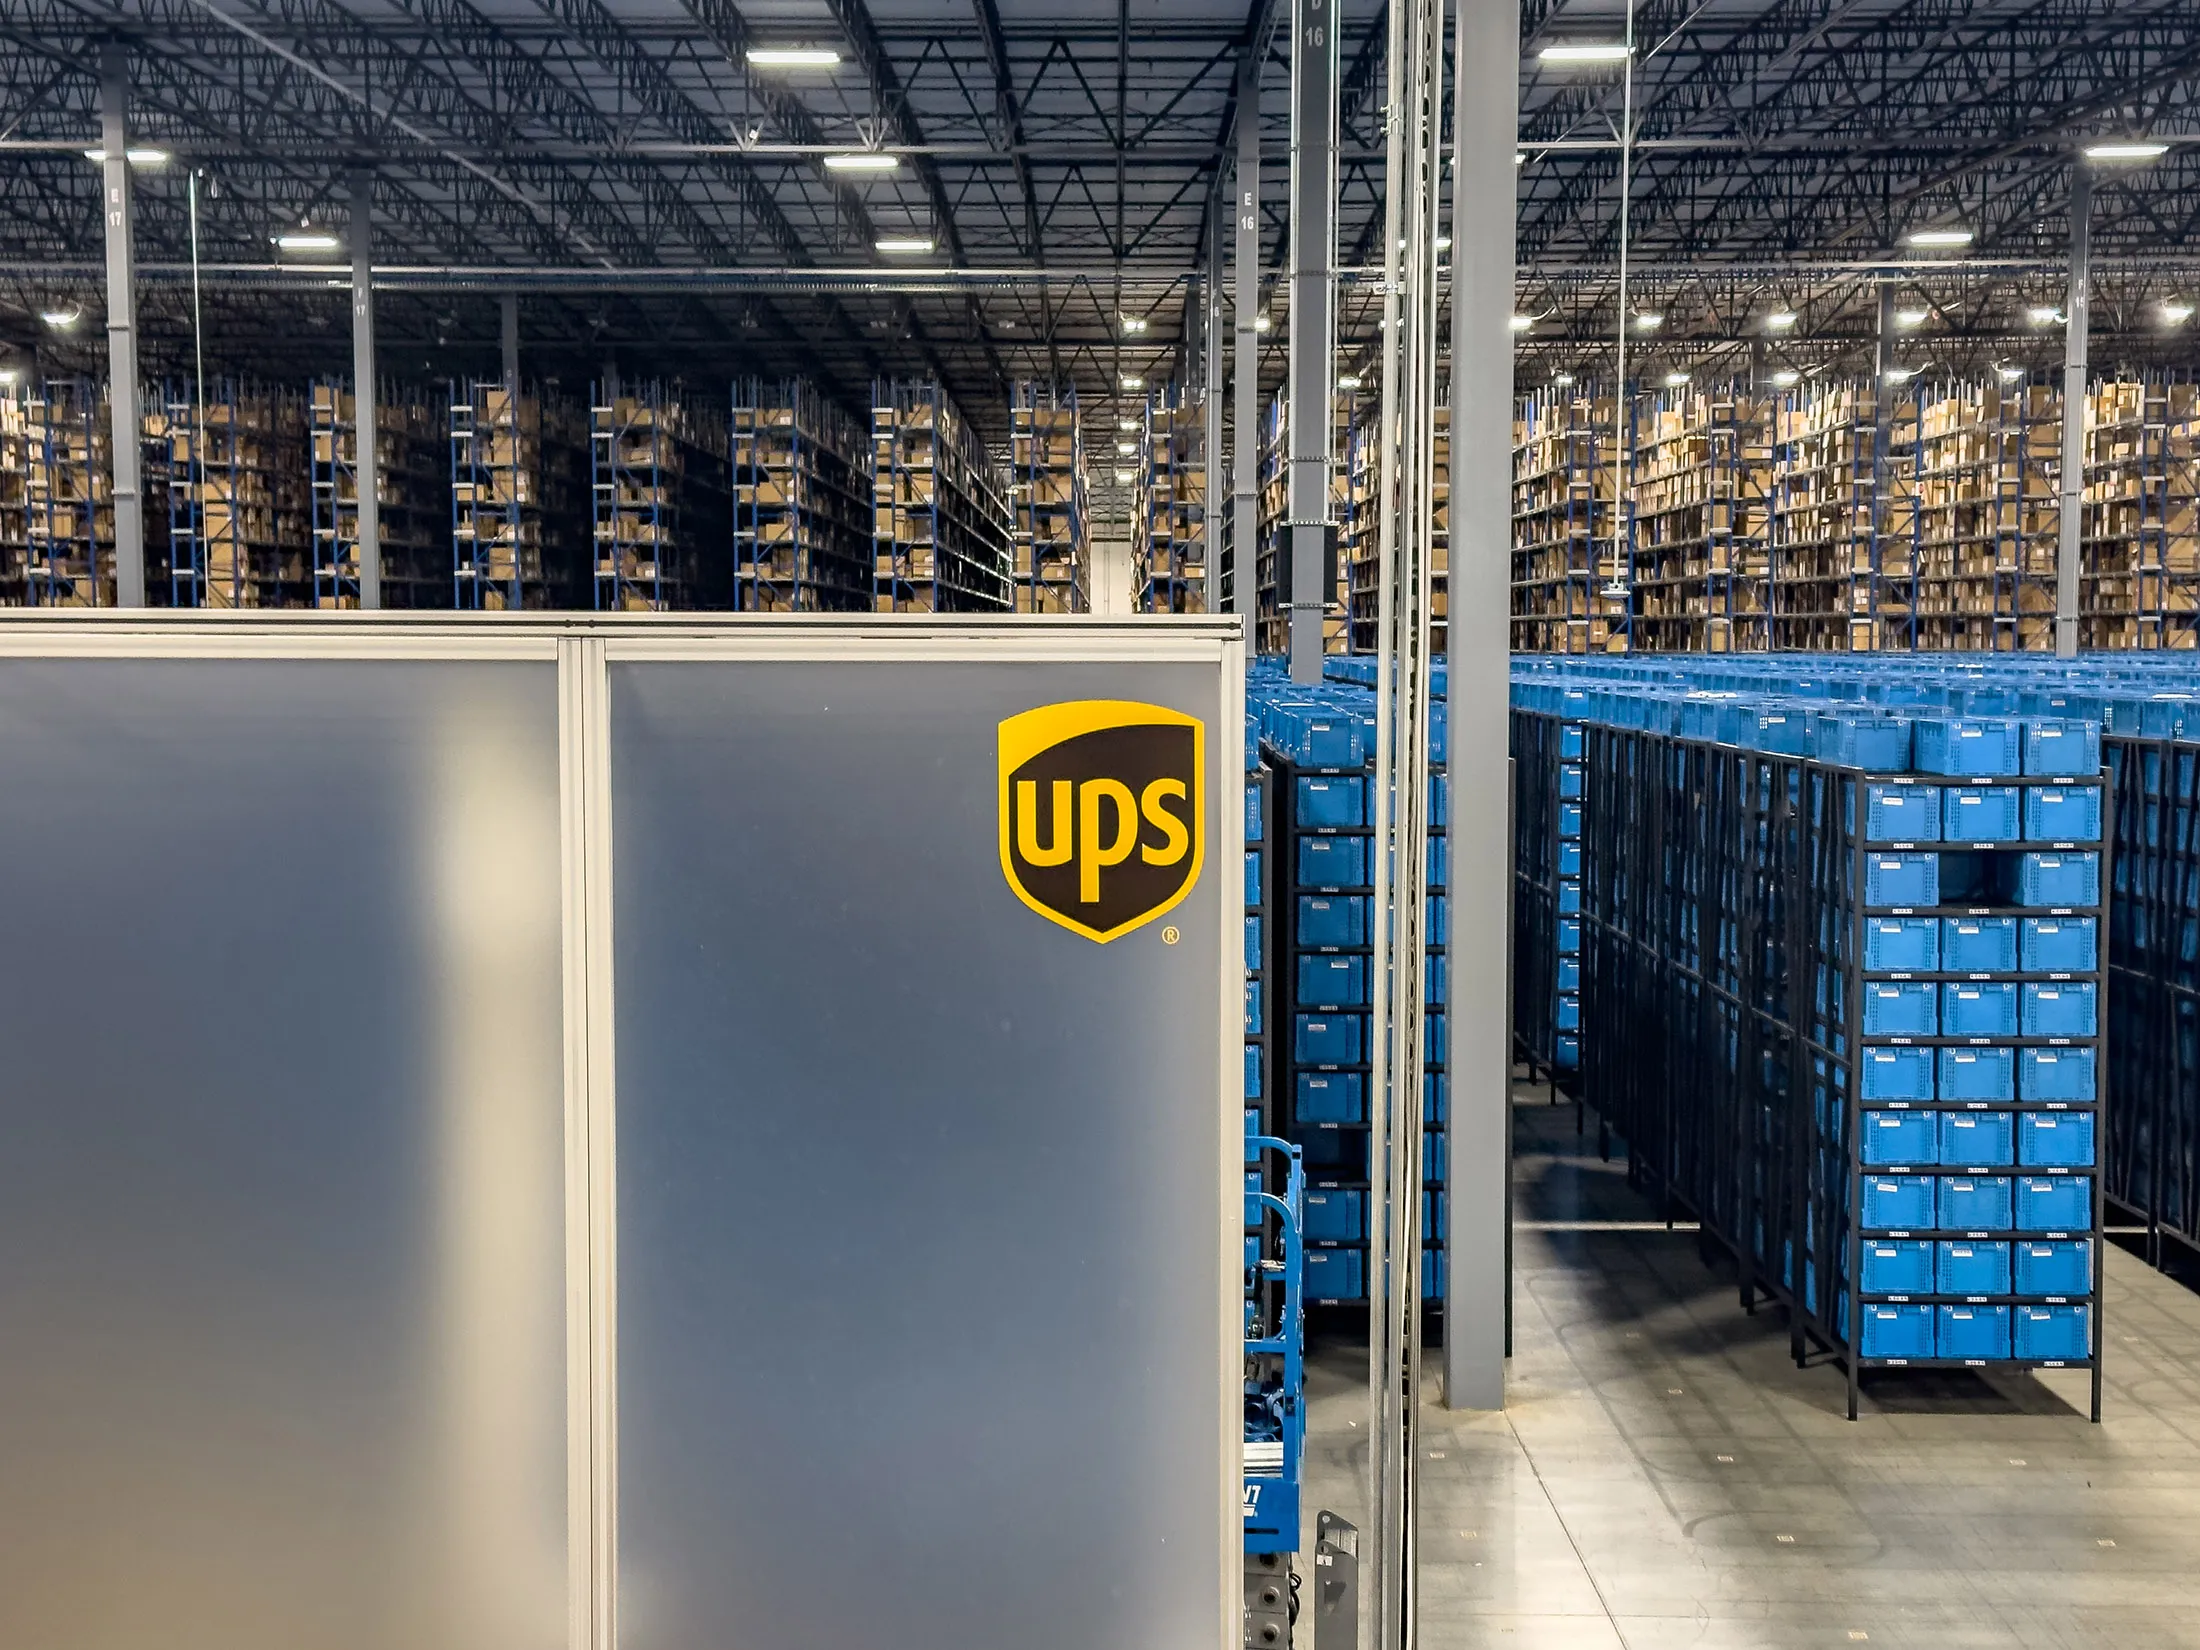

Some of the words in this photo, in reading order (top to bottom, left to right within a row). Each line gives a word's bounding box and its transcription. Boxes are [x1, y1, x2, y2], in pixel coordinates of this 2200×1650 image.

[1305, 25, 1324, 47] 16
[1244, 192, 1252, 206] E
[109, 211, 121, 226] 17
[1241, 216, 1254, 230] 16
[356, 304, 366, 317] 17
[1016, 777, 1190, 904] ups
